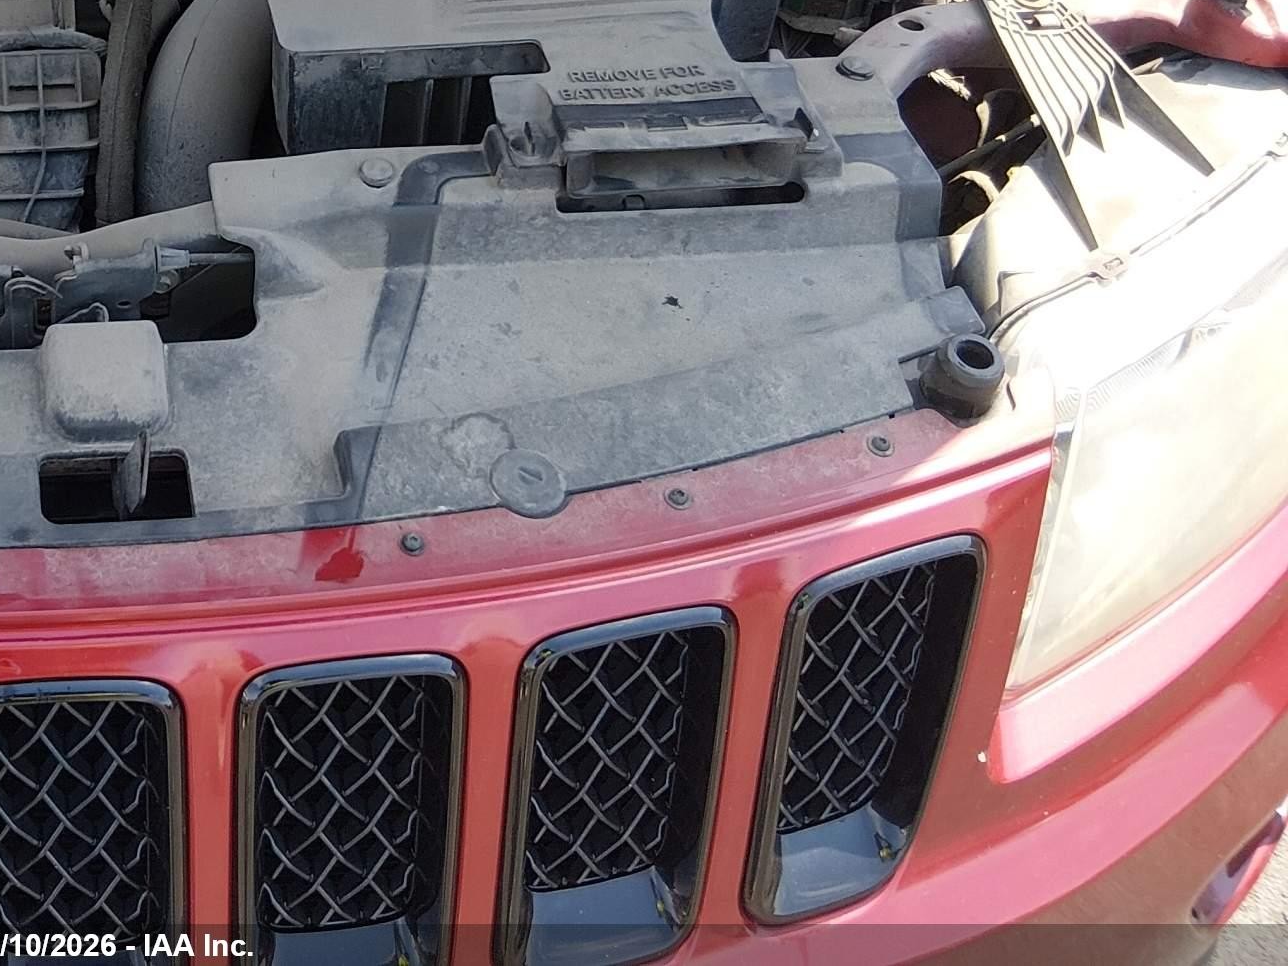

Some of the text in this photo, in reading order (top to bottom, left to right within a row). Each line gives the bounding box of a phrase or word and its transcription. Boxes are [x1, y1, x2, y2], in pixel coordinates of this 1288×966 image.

[567, 64, 705, 83] REMOVE FOR
[558, 78, 736, 101] BATTERY ACCESS
